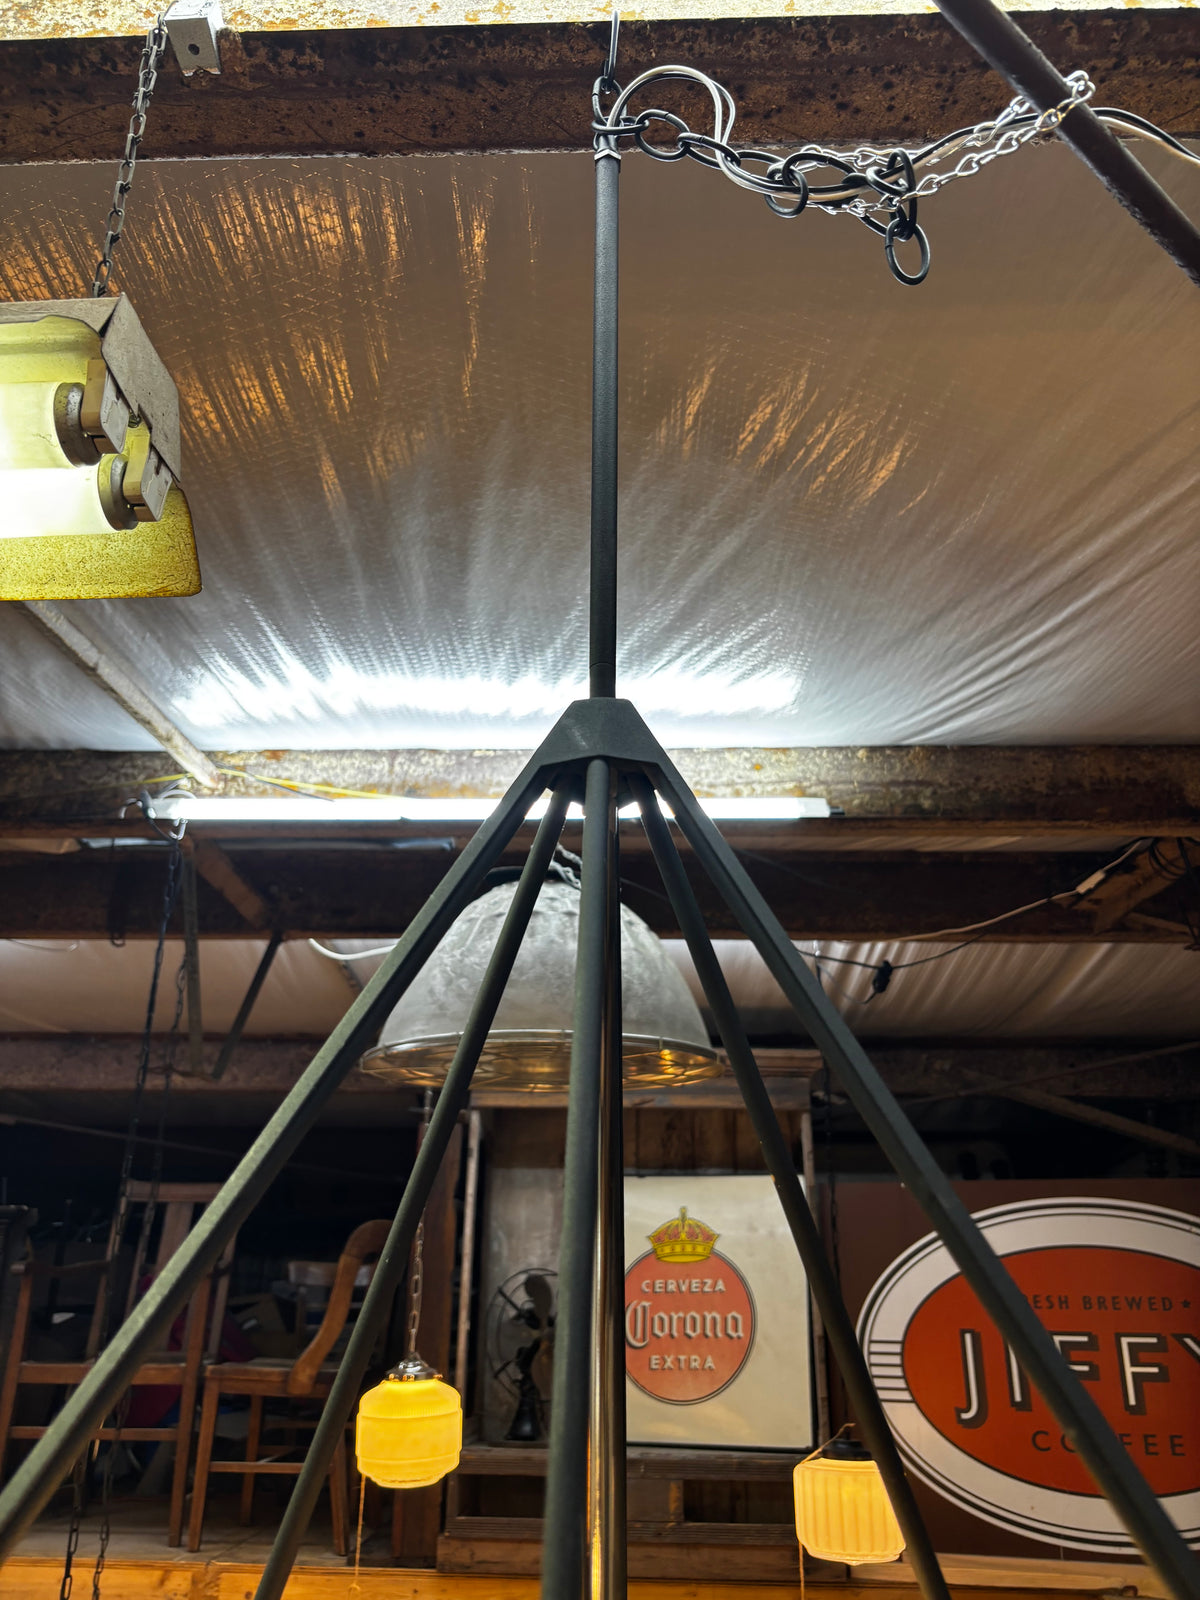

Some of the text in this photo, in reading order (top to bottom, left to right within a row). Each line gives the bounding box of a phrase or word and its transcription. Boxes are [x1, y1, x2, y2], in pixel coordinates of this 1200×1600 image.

[641, 1279, 726, 1294] CERVEZA
[1024, 1294, 1174, 1312] ESH BREWED
[625, 1300, 745, 1349] Corona
[649, 1354, 716, 1370] EXTRA
